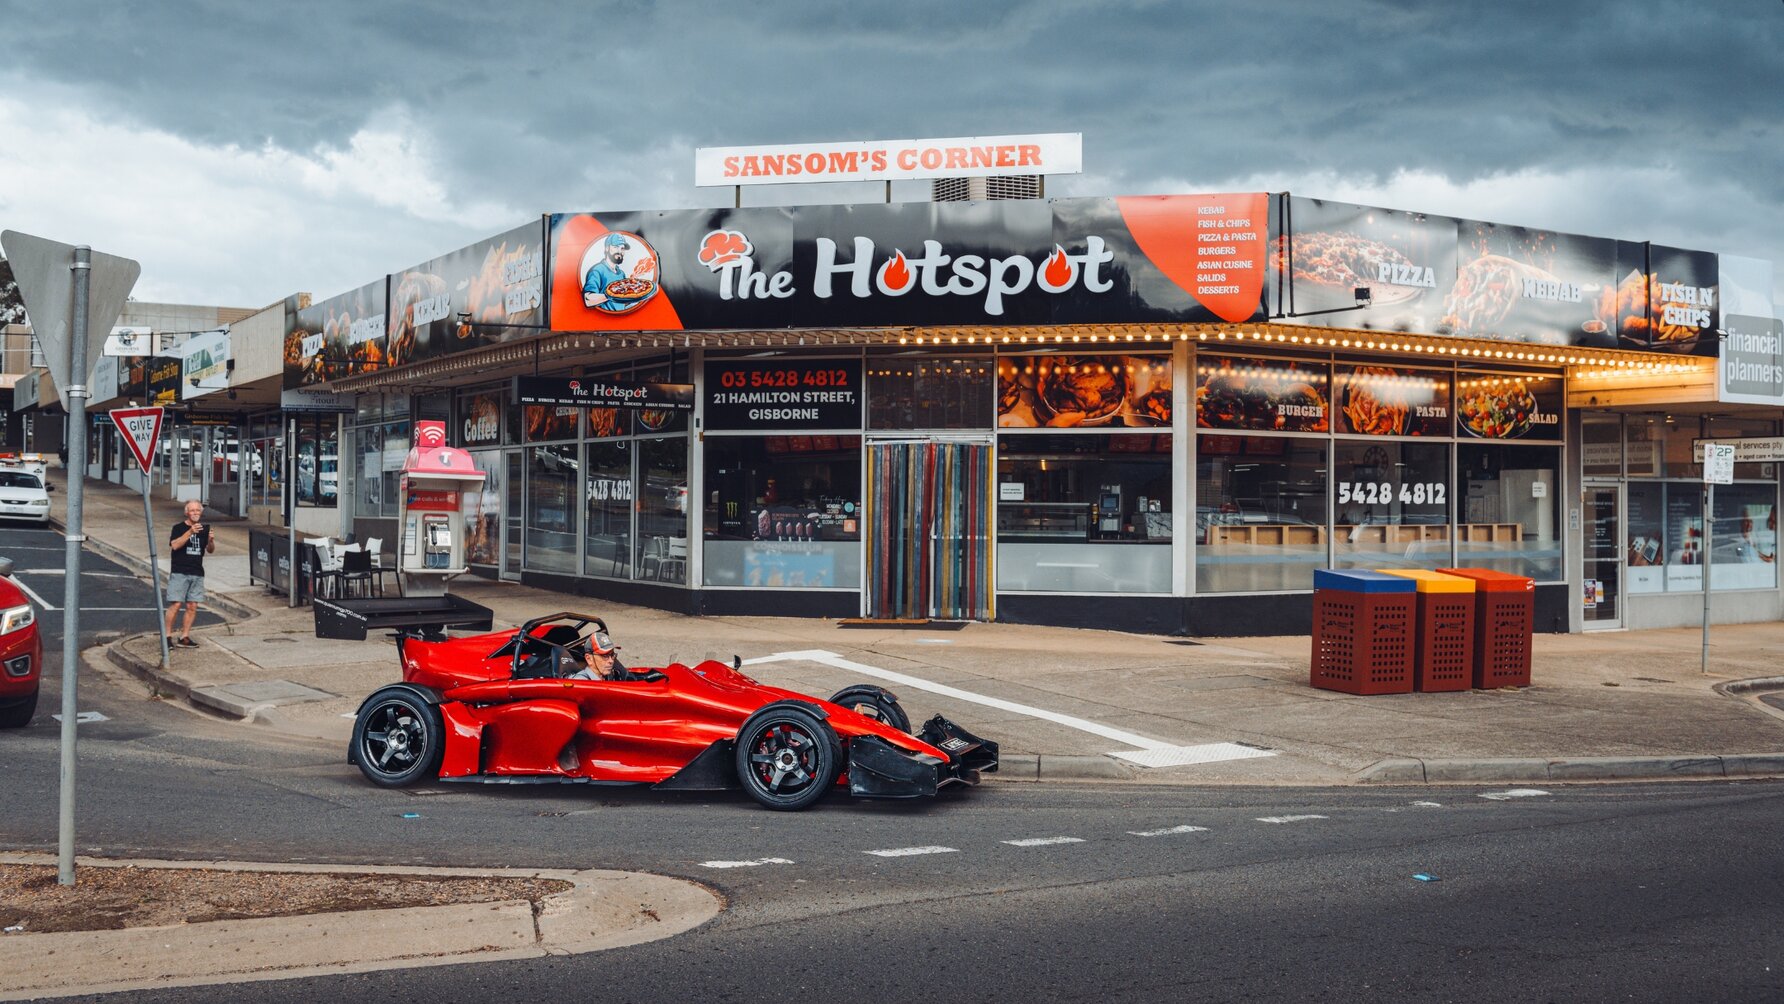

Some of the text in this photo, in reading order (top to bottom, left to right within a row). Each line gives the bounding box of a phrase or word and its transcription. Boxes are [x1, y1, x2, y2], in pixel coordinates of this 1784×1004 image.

[723, 144, 1043, 177] SANSOM'S CORNER
[1198, 207, 1225, 215] KEBAB
[1198, 219, 1250, 228] FISH & CHIPS
[1198, 233, 1222, 242] PIZZA
[1223, 233, 1231, 241] &
[1198, 247, 1236, 255] BURGERS
[1197, 260, 1253, 269] ASIAN CUSINE
[714, 235, 1115, 316] The Hotspot
[1378, 262, 1436, 288] PIZZA
[1198, 286, 1239, 294] DESSERTS
[1521, 277, 1582, 303] KEBAB
[1660, 282, 1713, 307] FISH N
[505, 285, 542, 315] CHIPS
[412, 294, 450, 328] KEBAB
[1663, 305, 1711, 329] CHIPS
[1727, 327, 1783, 356] financial
[721, 370, 847, 387] 03 5428 4812
[1727, 357, 1783, 385] planners
[571, 384, 647, 400] The Hotspot
[713, 391, 855, 405] 21 HAMILTON STREET,
[749, 408, 819, 420] GISBORNE
[1278, 404, 1323, 418] BURGER
[1416, 406, 1447, 418] PASTA
[1529, 413, 1558, 424] SALAD
[129, 419, 153, 432] GIVE
[464, 418, 498, 442] Coffee
[135, 432, 151, 442] WAY
[1716, 447, 1733, 457] 2P
[1742, 442, 1771, 450] services
[588, 480, 631, 500] 5428 4812
[1338, 482, 1446, 505] 5428 4812
